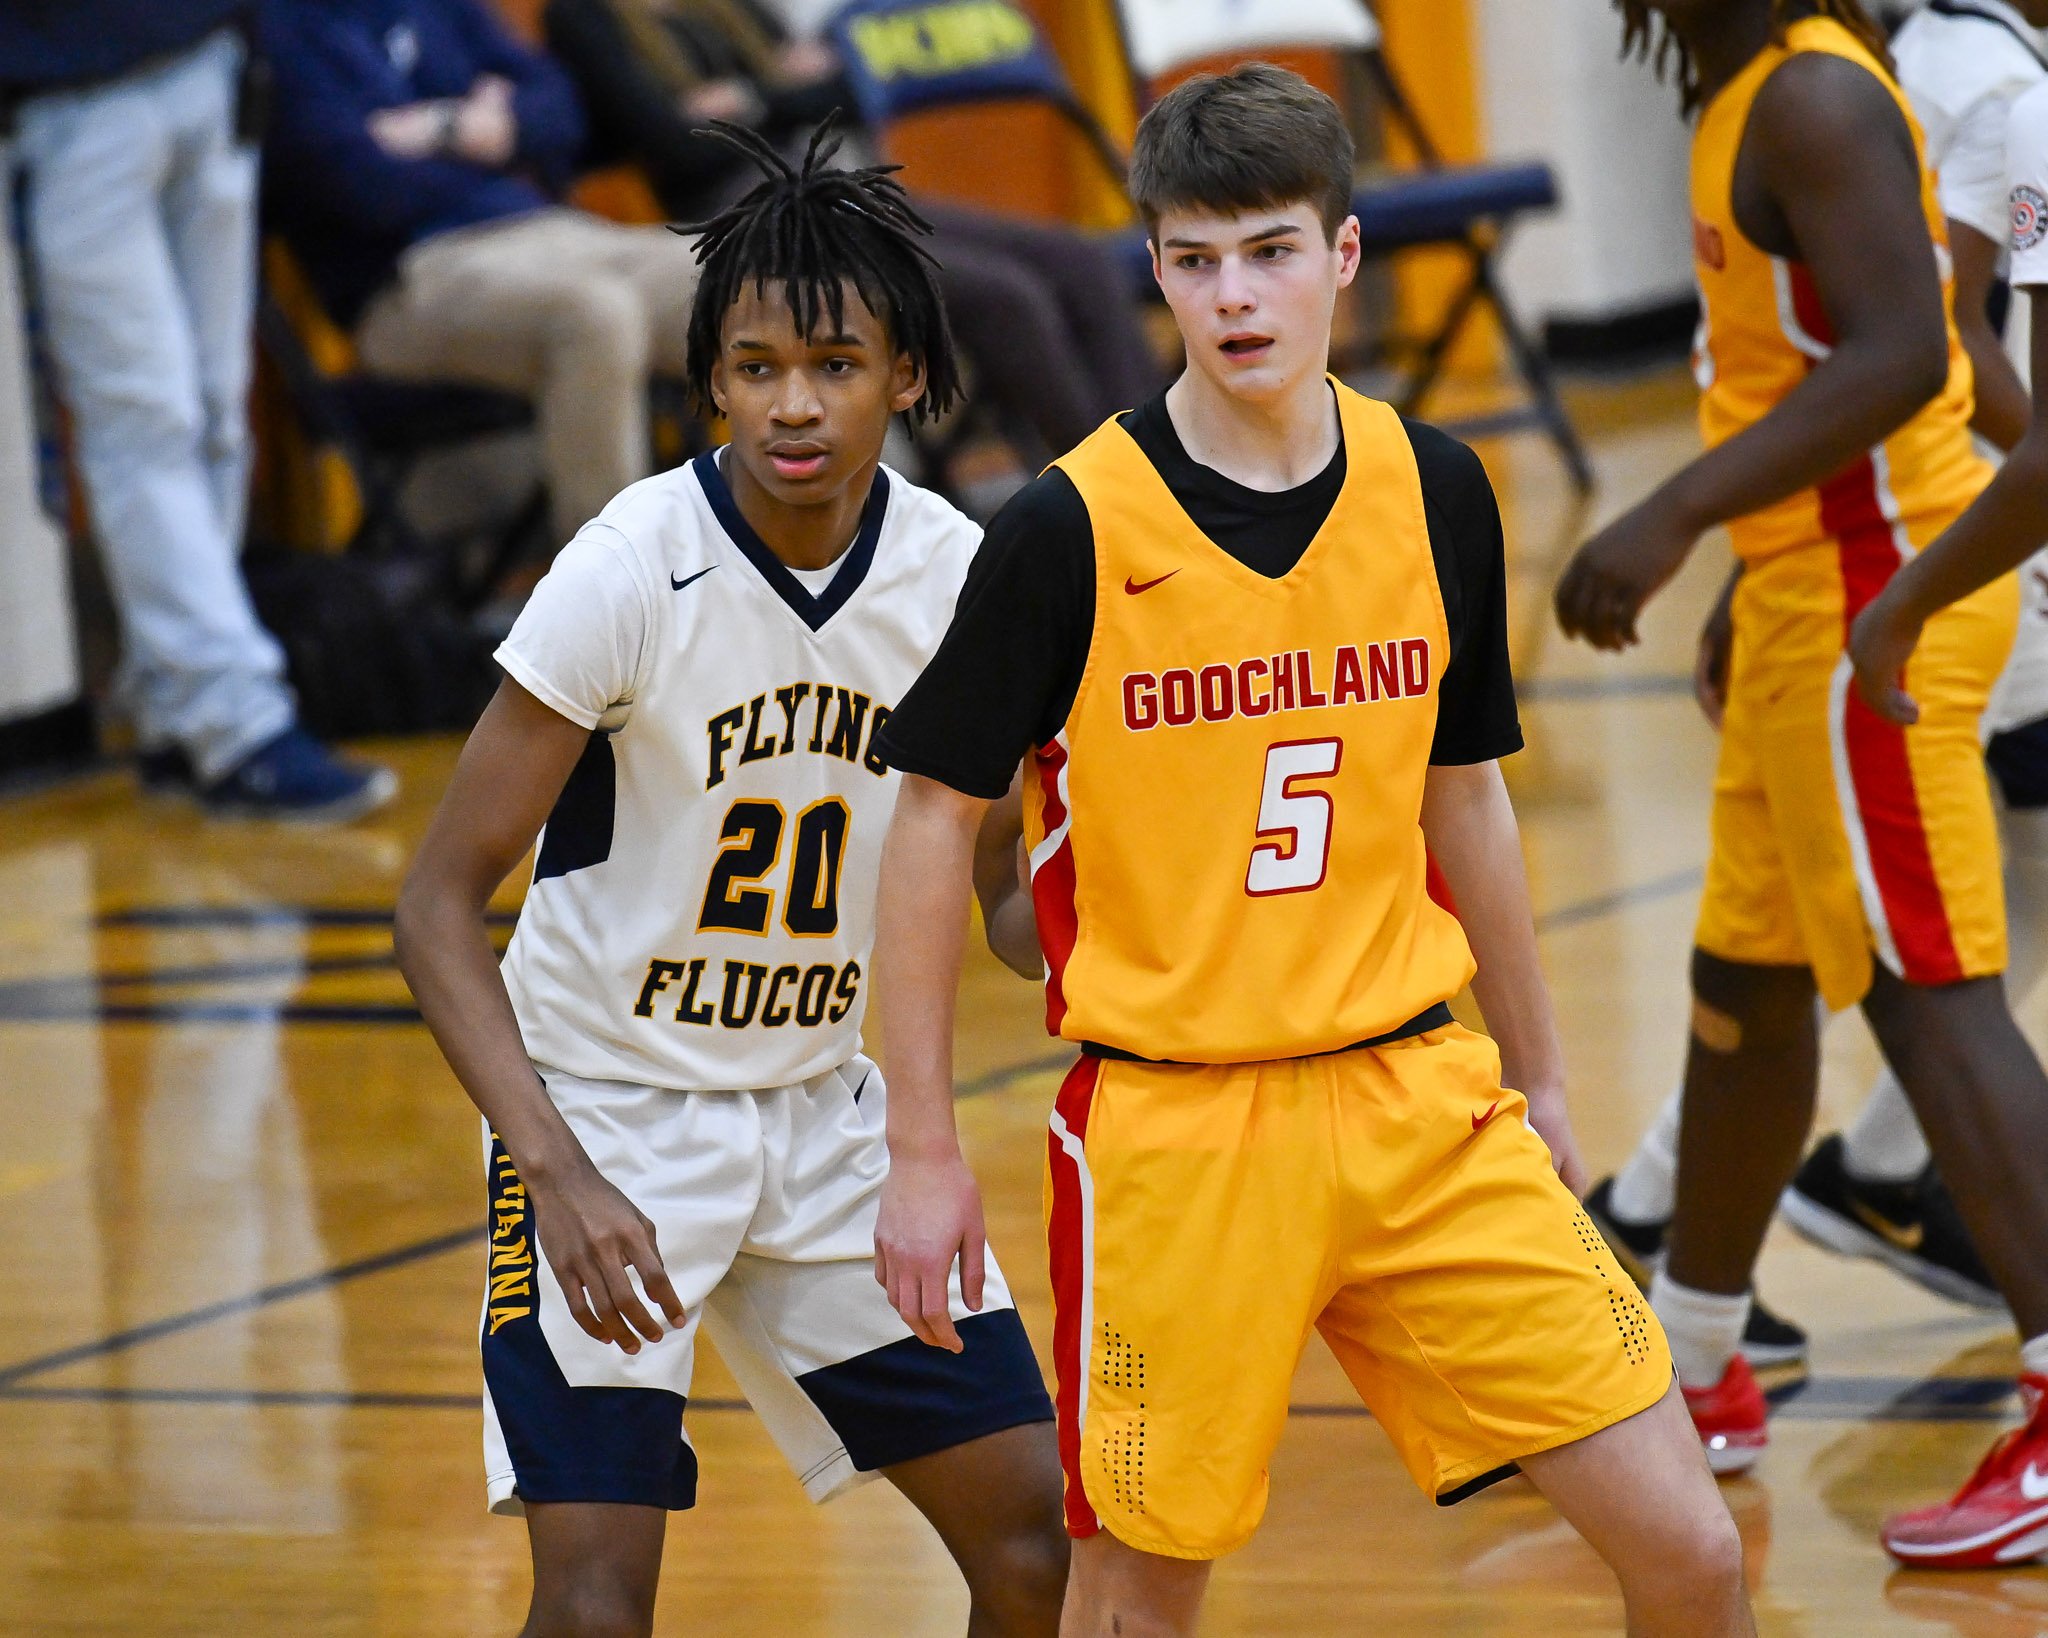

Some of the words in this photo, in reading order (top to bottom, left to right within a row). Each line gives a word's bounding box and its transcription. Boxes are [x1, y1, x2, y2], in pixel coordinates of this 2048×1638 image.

[1122, 637, 1429, 732] GOOCHLAND
[695, 795, 852, 938] 20
[1244, 736, 1343, 897] 5
[633, 957, 861, 1028] FLUCOS
